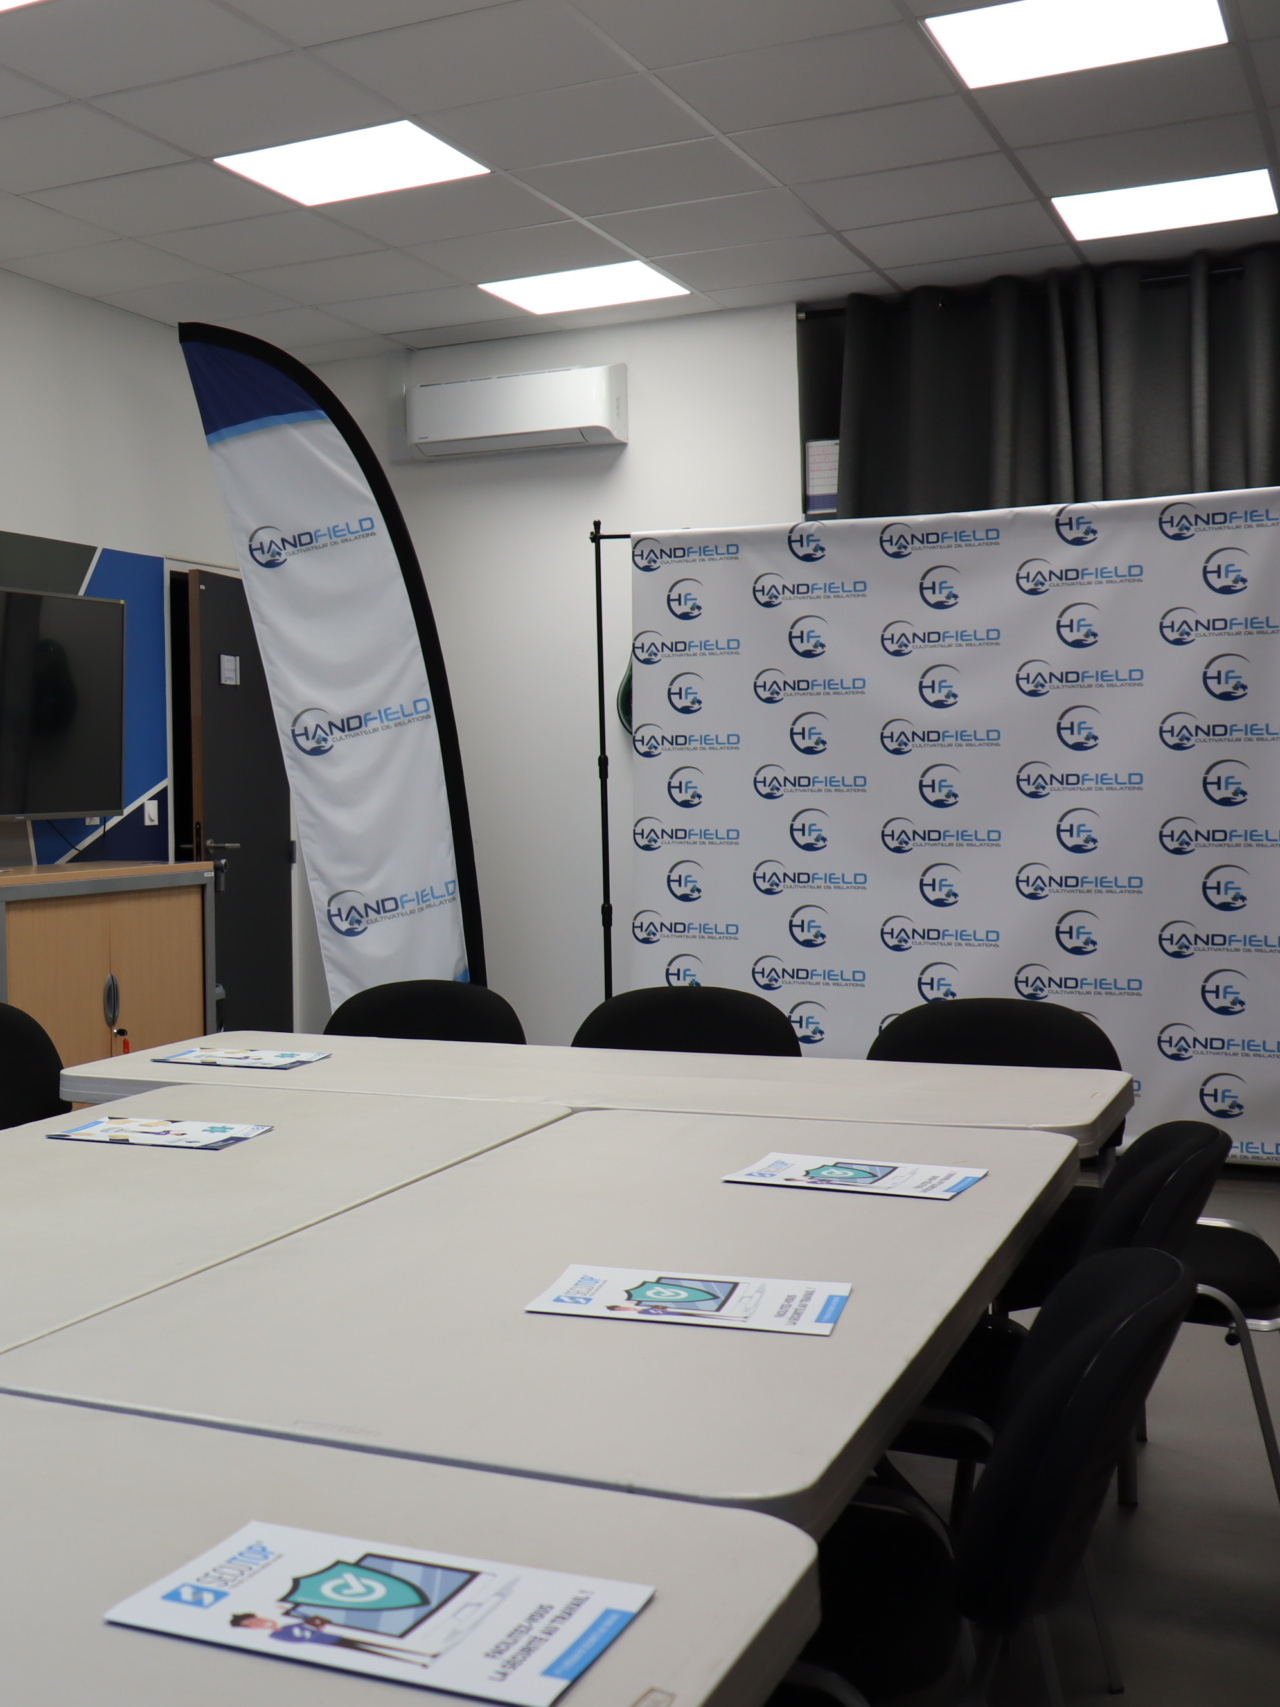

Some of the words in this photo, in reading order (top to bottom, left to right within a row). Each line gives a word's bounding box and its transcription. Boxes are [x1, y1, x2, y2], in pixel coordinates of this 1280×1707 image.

[249, 517, 374, 554] HANDFIELD
[880, 528, 1000, 546] HANDFIELD
[632, 544, 739, 560] HANDFIELD
[1016, 565, 1143, 583] HANDFIELD
[753, 581, 866, 596] HANDFIELD
[881, 629, 1000, 644] HANDFIELD
[633, 639, 740, 653] HANDFIELD
[1016, 669, 1143, 684] HANDFIELD
[754, 678, 865, 692] HANDFIELD
[291, 698, 430, 740] HANDFIELD
[881, 729, 1000, 742] HANDFIELD
[1160, 724, 1280, 737] HANDFIEL
[633, 734, 740, 746] HANDFIELD
[754, 776, 866, 787] HANDFIELD
[1016, 773, 1143, 785] HANDFIELD
[633, 829, 740, 840] HANDFIELD
[882, 830, 1001, 841] HANDFIELD
[1160, 830, 1280, 842] HANDFIEL
[753, 872, 867, 884] HANDFIELD
[1016, 876, 1143, 888] HANDFIELD
[327, 880, 456, 921] HANDFIELD
[632, 922, 738, 935] HANDFIELD
[880, 928, 1000, 942] HANDFIELD
[1159, 934, 1280, 948] HANDFIEL
[752, 968, 866, 982] HANDFIELD
[1015, 976, 1142, 990] HANDFIELD
[1157, 1036, 1280, 1052] HANDFIEL
[195, 1542, 277, 1588] SECUTOP
